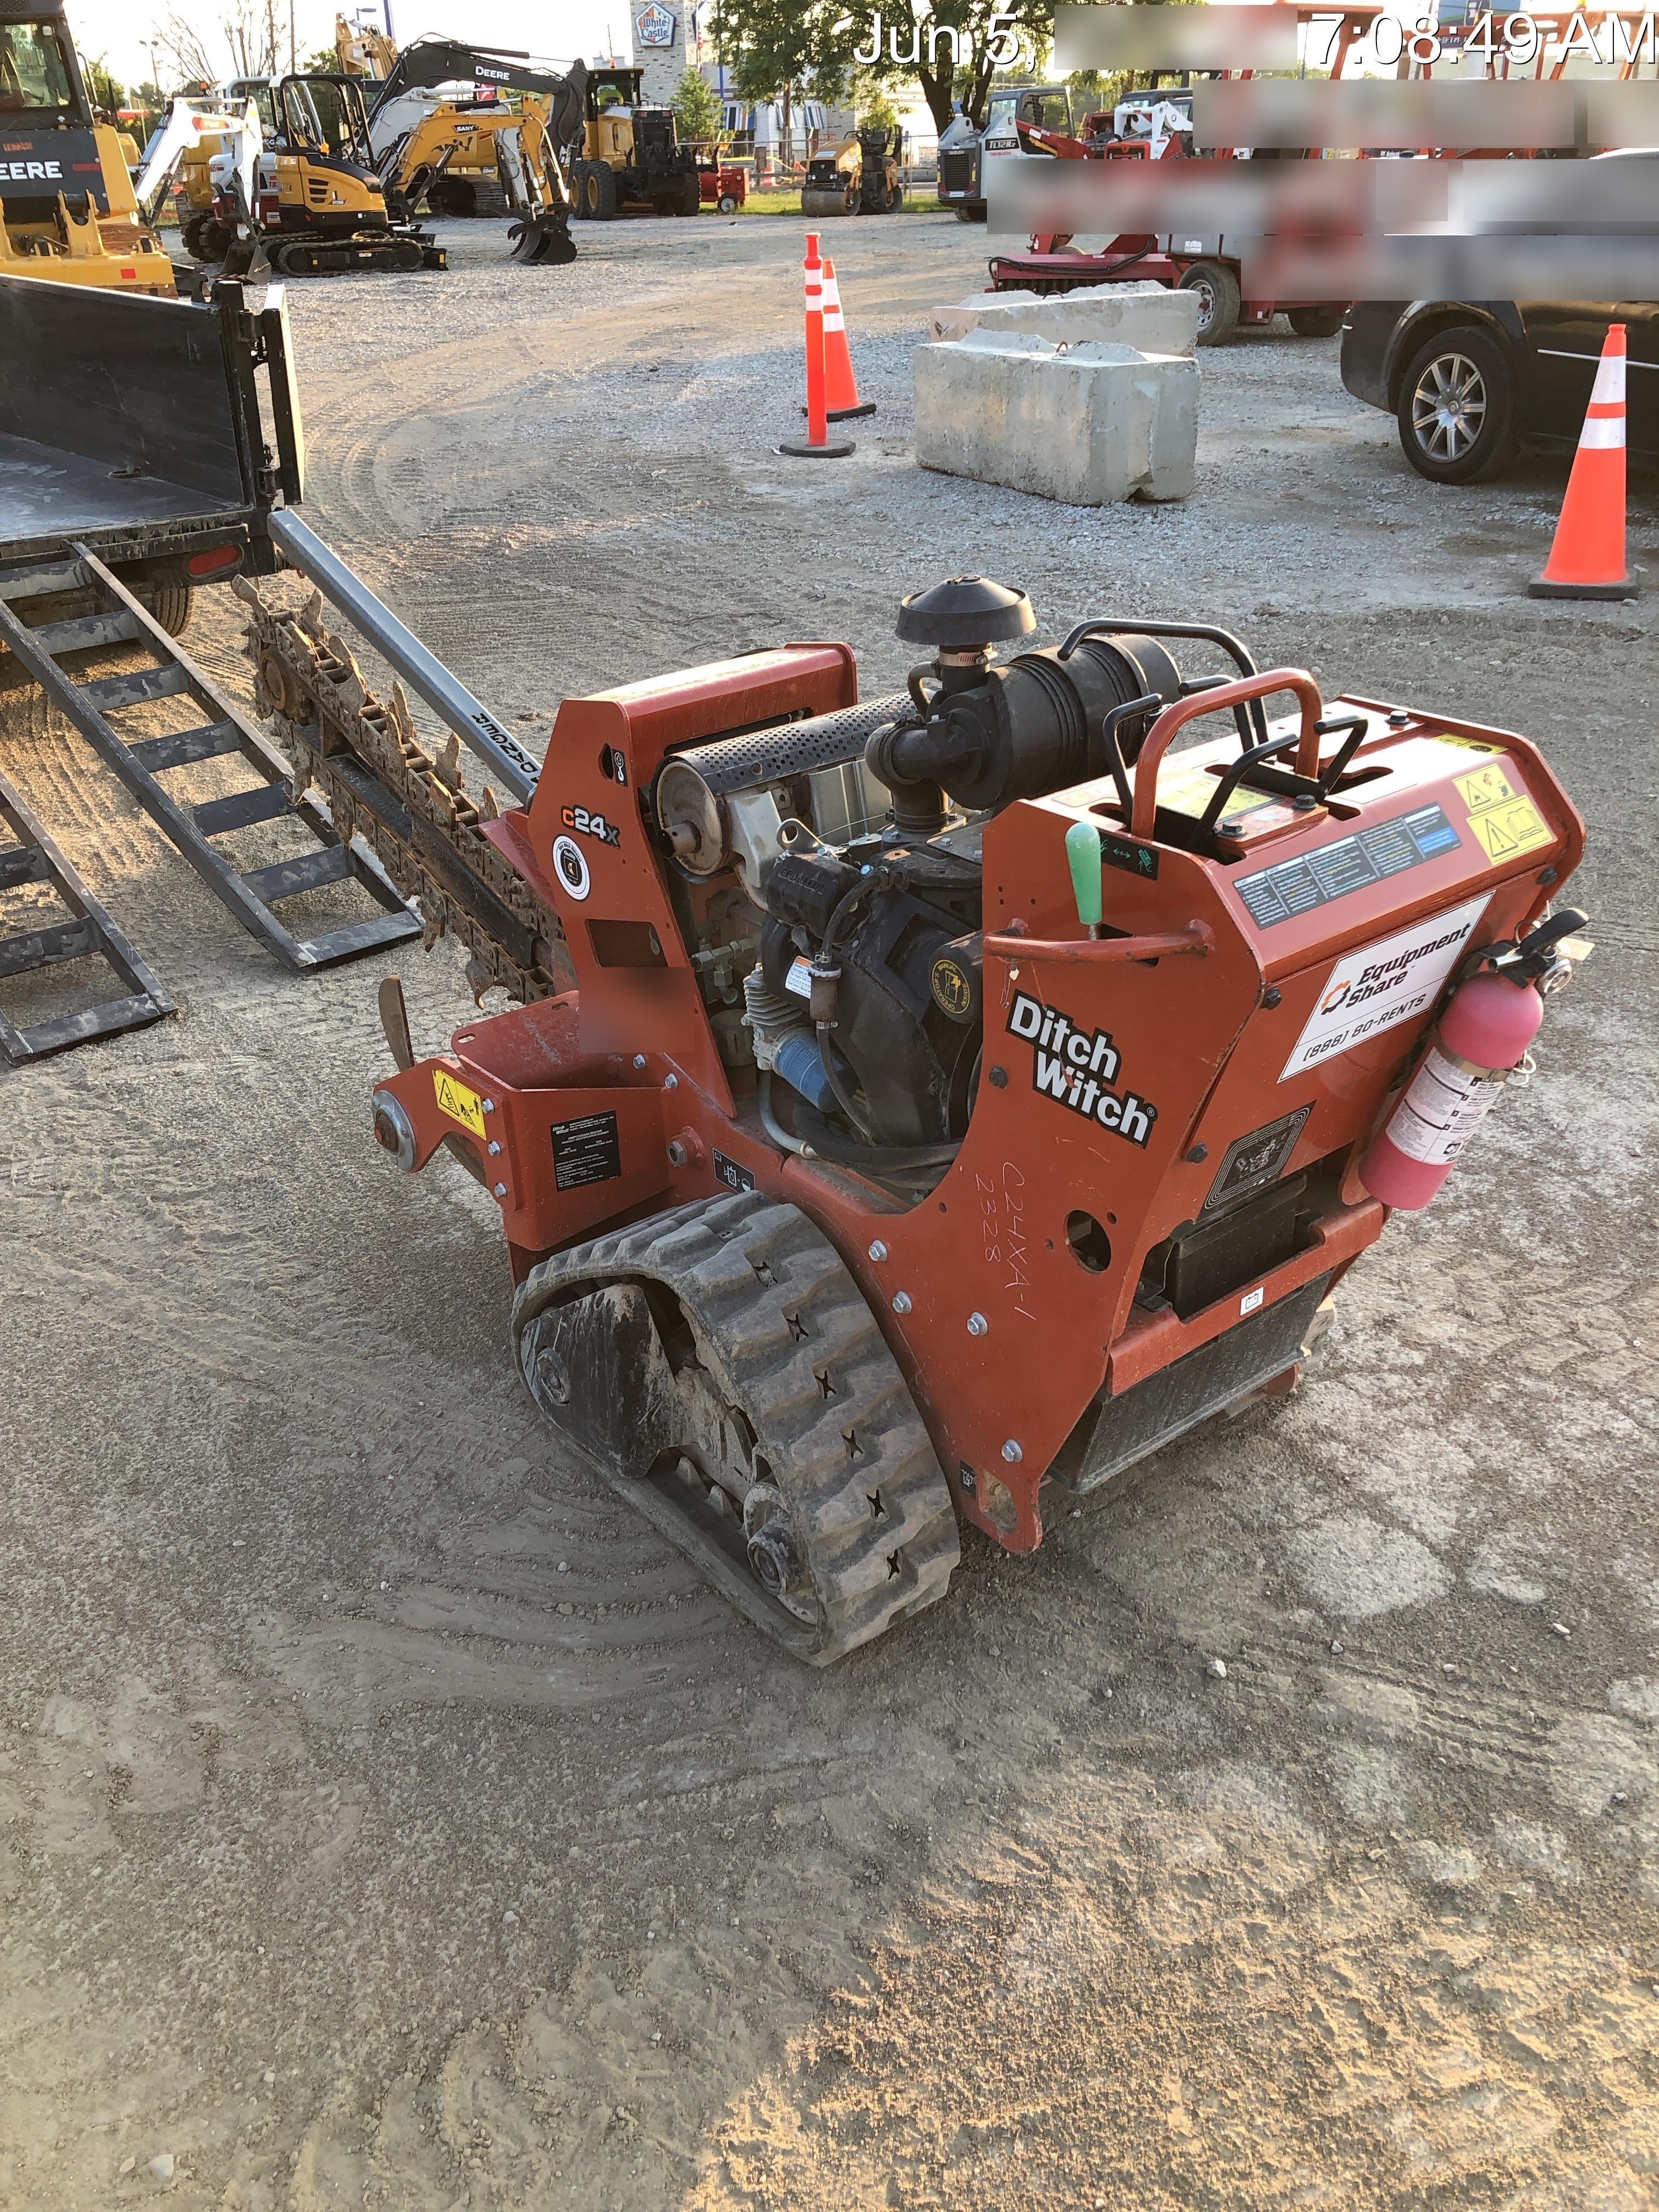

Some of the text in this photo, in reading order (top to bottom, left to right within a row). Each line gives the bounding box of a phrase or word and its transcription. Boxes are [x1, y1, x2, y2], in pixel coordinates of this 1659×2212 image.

[641, 27, 668, 37] Castle
[644, 18, 667, 29] White
[475, 65, 510, 81] DEERE
[471, 713, 538, 773] DANGER
[1357, 922, 1471, 986] Equipment
[1346, 970, 1408, 1008] Share
[1011, 995, 1118, 1079] Ditch
[1303, 993, 1426, 1062] (888) 80-RENTS
[1036, 1050, 1148, 1142] Witch
[975, 1172, 1001, 1262] 2328
